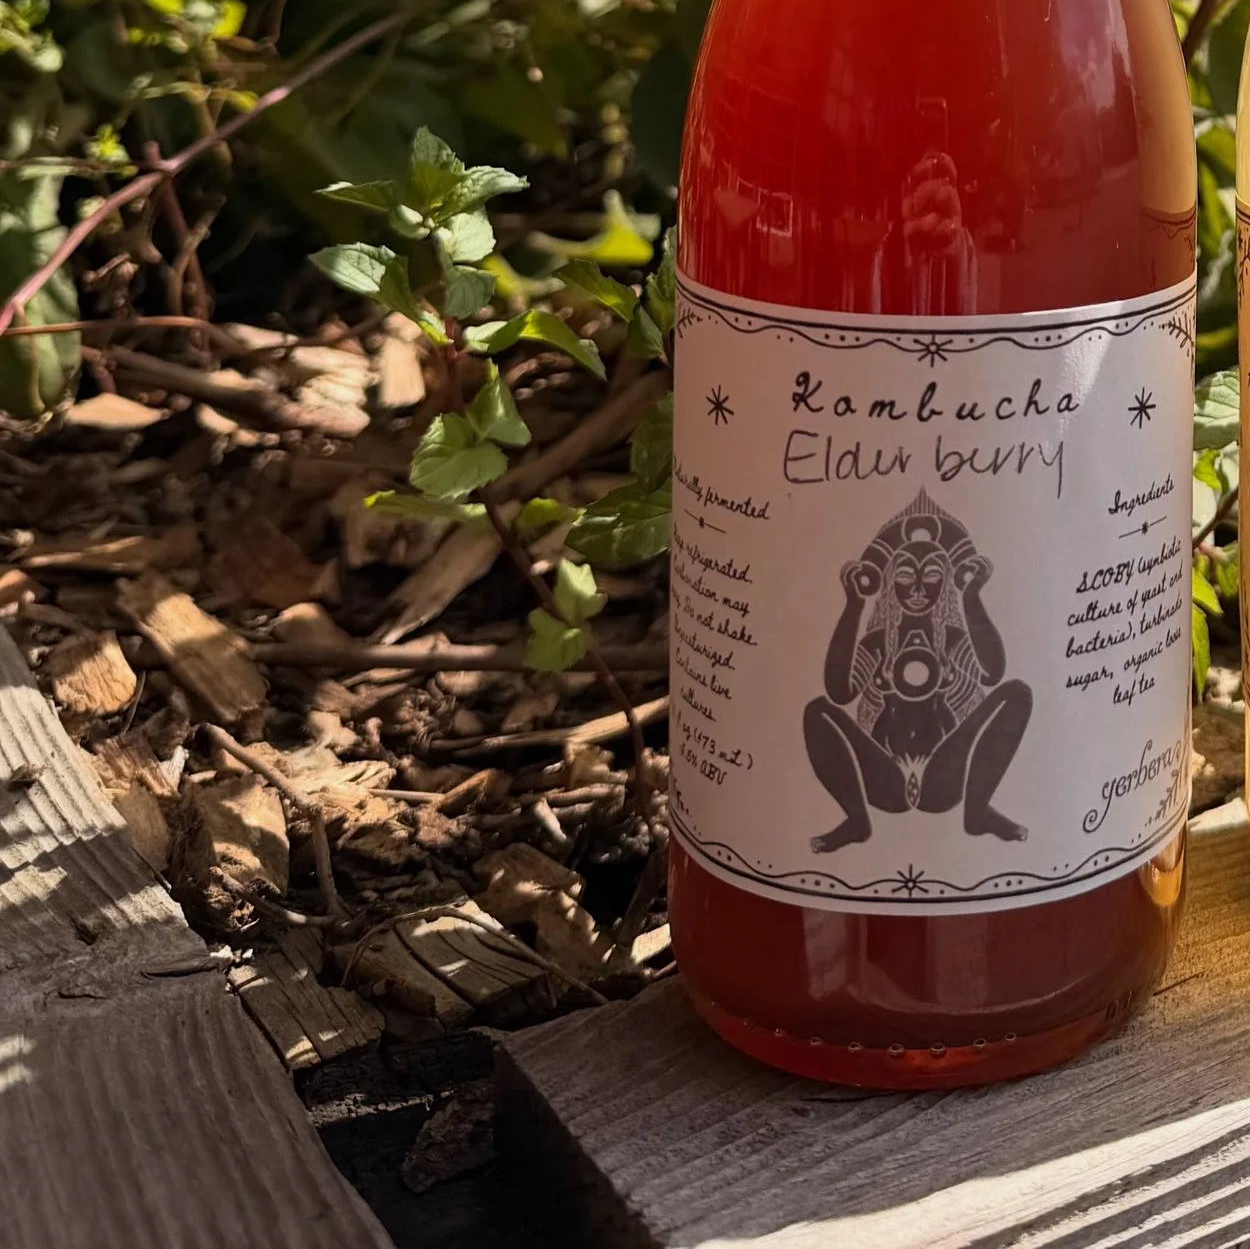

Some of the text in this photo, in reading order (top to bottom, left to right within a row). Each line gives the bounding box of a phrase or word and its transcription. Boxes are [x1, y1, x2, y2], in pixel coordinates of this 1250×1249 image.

[703, 486, 771, 520] fermented
[1108, 472, 1175, 517] Ingredients
[1076, 558, 1135, 594] SCOBY
[721, 596, 750, 618] may
[1067, 563, 1183, 627] culture of yeast and
[696, 611, 715, 631] not
[1065, 666, 1114, 692] sugar,
[1124, 641, 1163, 674] organic
[710, 674, 732, 700] live
[1113, 671, 1156, 707] leaf tea
[700, 759, 728, 785] ABV
